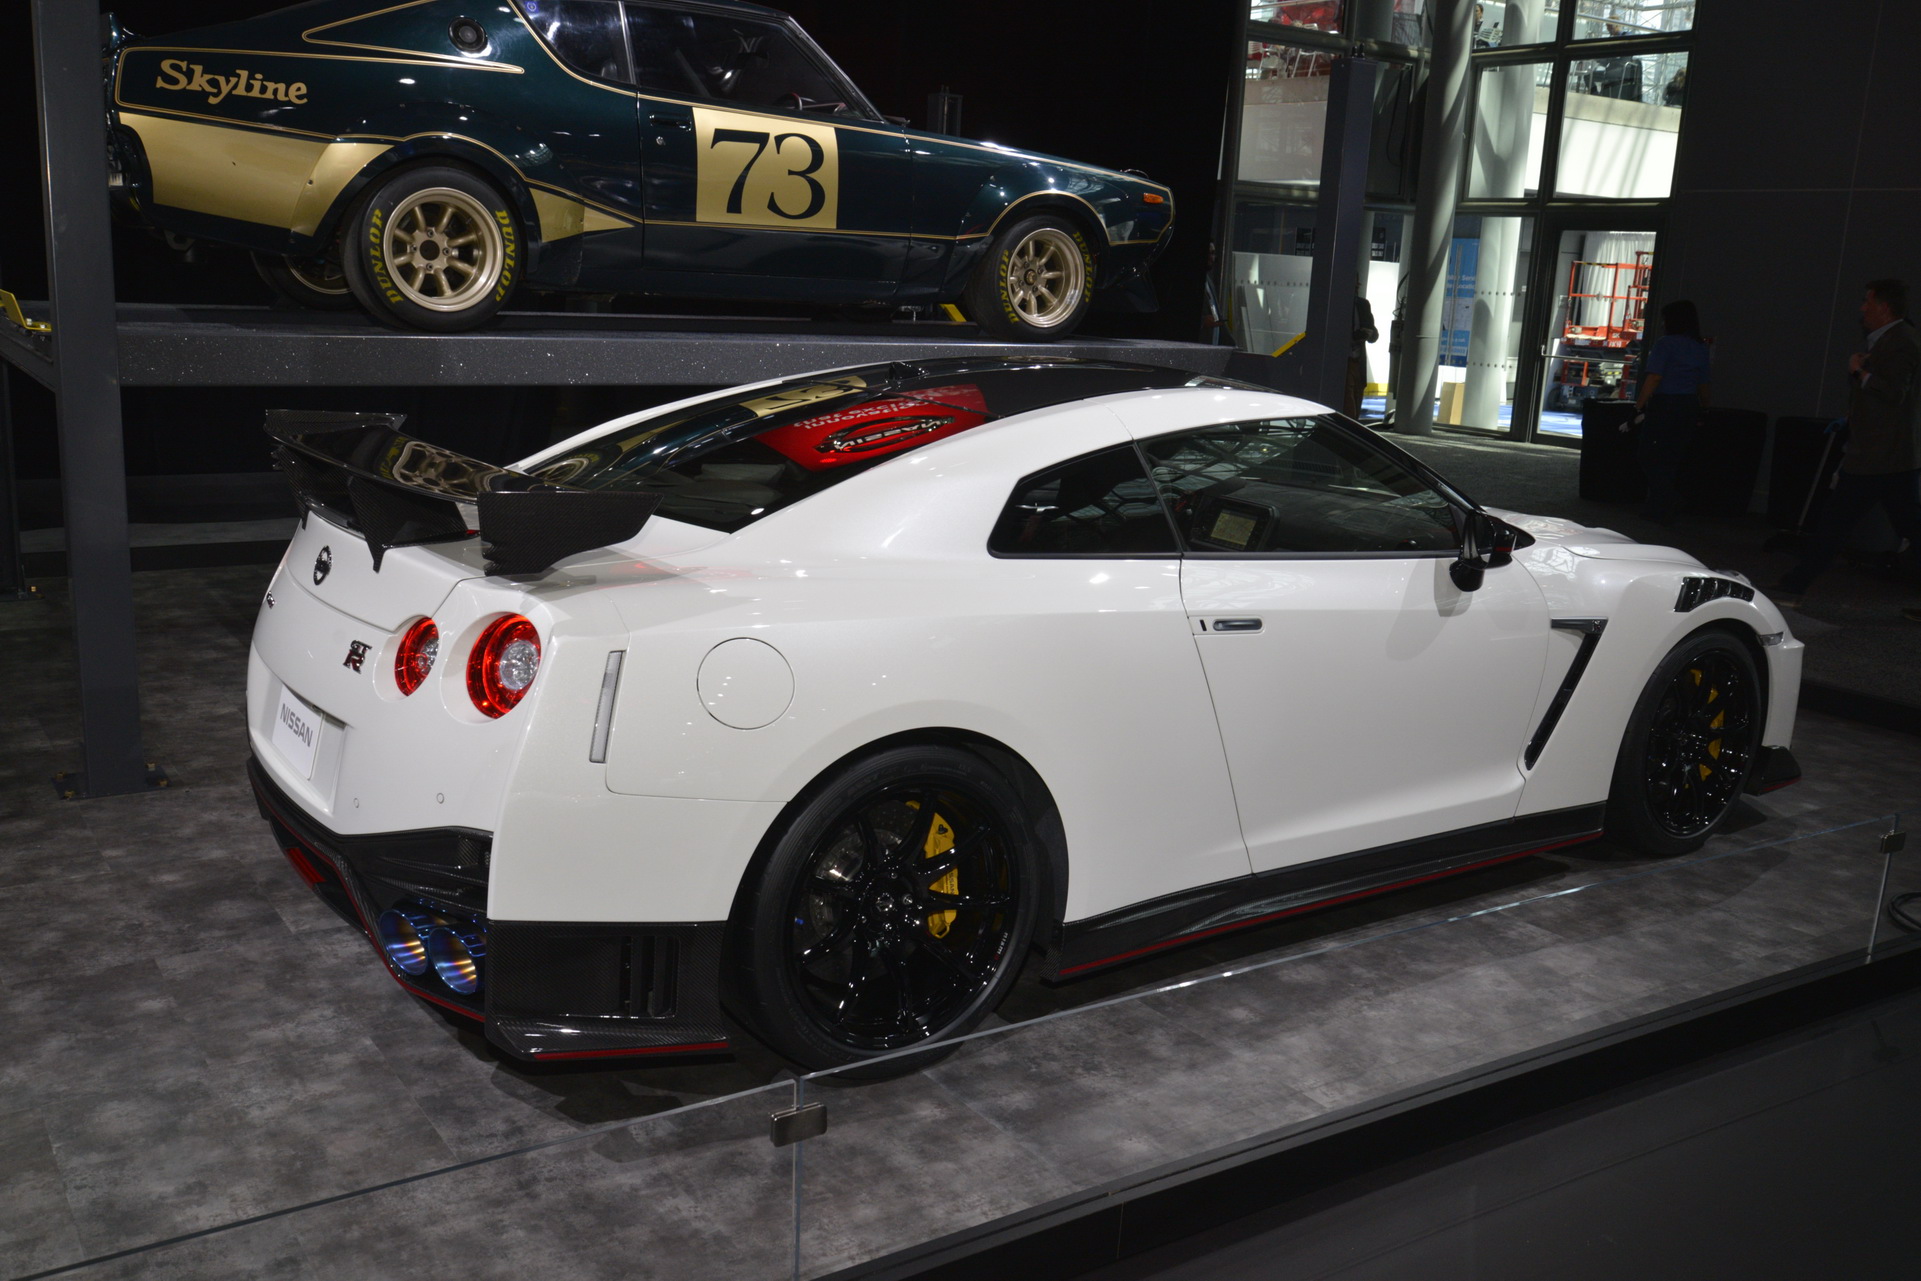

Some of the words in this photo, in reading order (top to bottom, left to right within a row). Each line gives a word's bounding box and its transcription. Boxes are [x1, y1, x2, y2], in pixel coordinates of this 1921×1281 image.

[156, 58, 307, 104] Skyline
[711, 128, 825, 220] 73
[368, 208, 404, 303] DUNLOP
[494, 210, 515, 302] DUNLOP
[999, 249, 1020, 323] DUNLOP
[1073, 231, 1093, 303] DUNLOP
[280, 703, 314, 747] NISSAN
